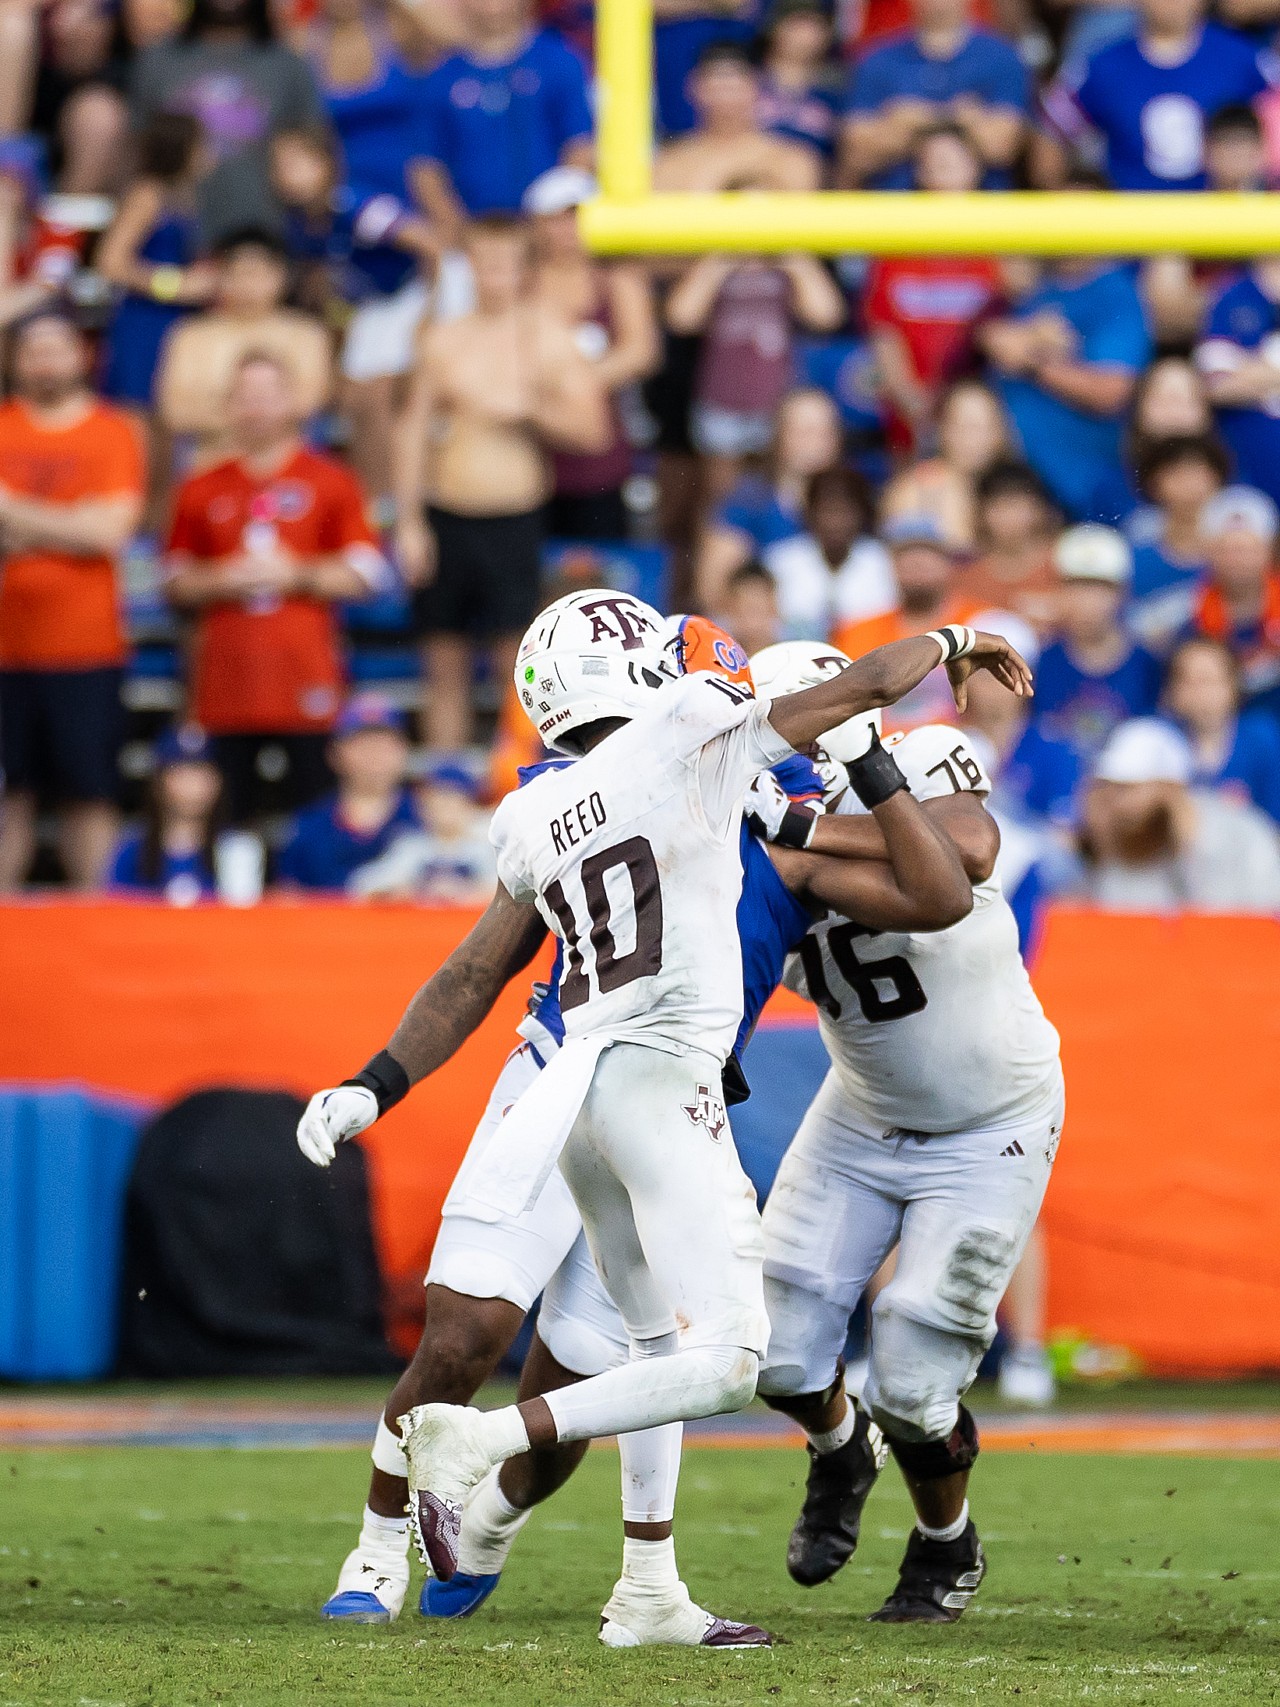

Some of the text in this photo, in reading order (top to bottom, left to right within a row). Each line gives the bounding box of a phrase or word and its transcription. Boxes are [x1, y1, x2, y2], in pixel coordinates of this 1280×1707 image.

[925, 745, 983, 793] 76
[550, 791, 607, 856] REED
[543, 835, 663, 1014] 10
